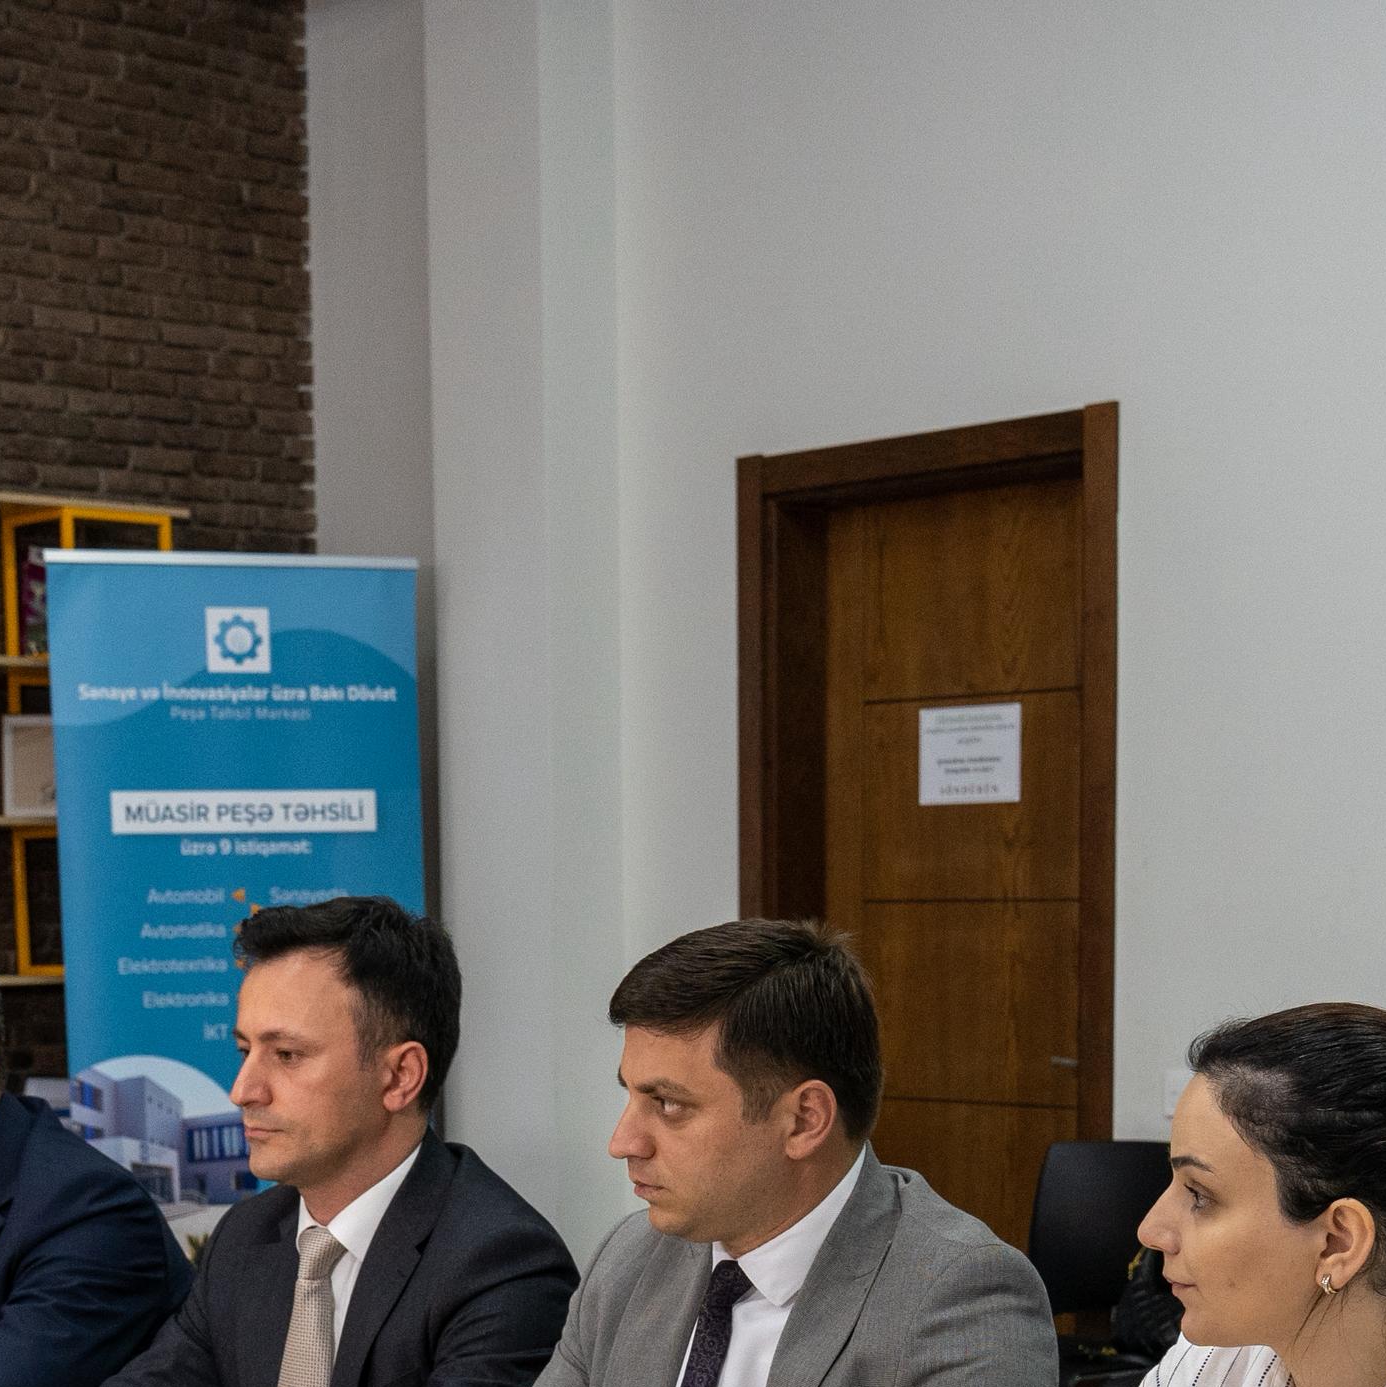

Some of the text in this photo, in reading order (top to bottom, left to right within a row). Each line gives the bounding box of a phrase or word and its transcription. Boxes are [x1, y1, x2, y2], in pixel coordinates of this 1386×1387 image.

[140, 687, 161, 701] və
[162, 681, 269, 703] İnnovasiyalar
[271, 684, 307, 701] üzrə
[310, 684, 345, 701] Bakı
[347, 684, 397, 702] Dövlət
[124, 798, 364, 826] MÜASİR PEŞƏ TƏHSİLİ
[180, 838, 215, 855] üzrə
[219, 838, 232, 855] 9
[147, 887, 226, 904] Avtomobil
[140, 922, 227, 939] Avtomatika
[117, 957, 228, 976] Elektrotexnika
[142, 990, 230, 1010] Elektronika
